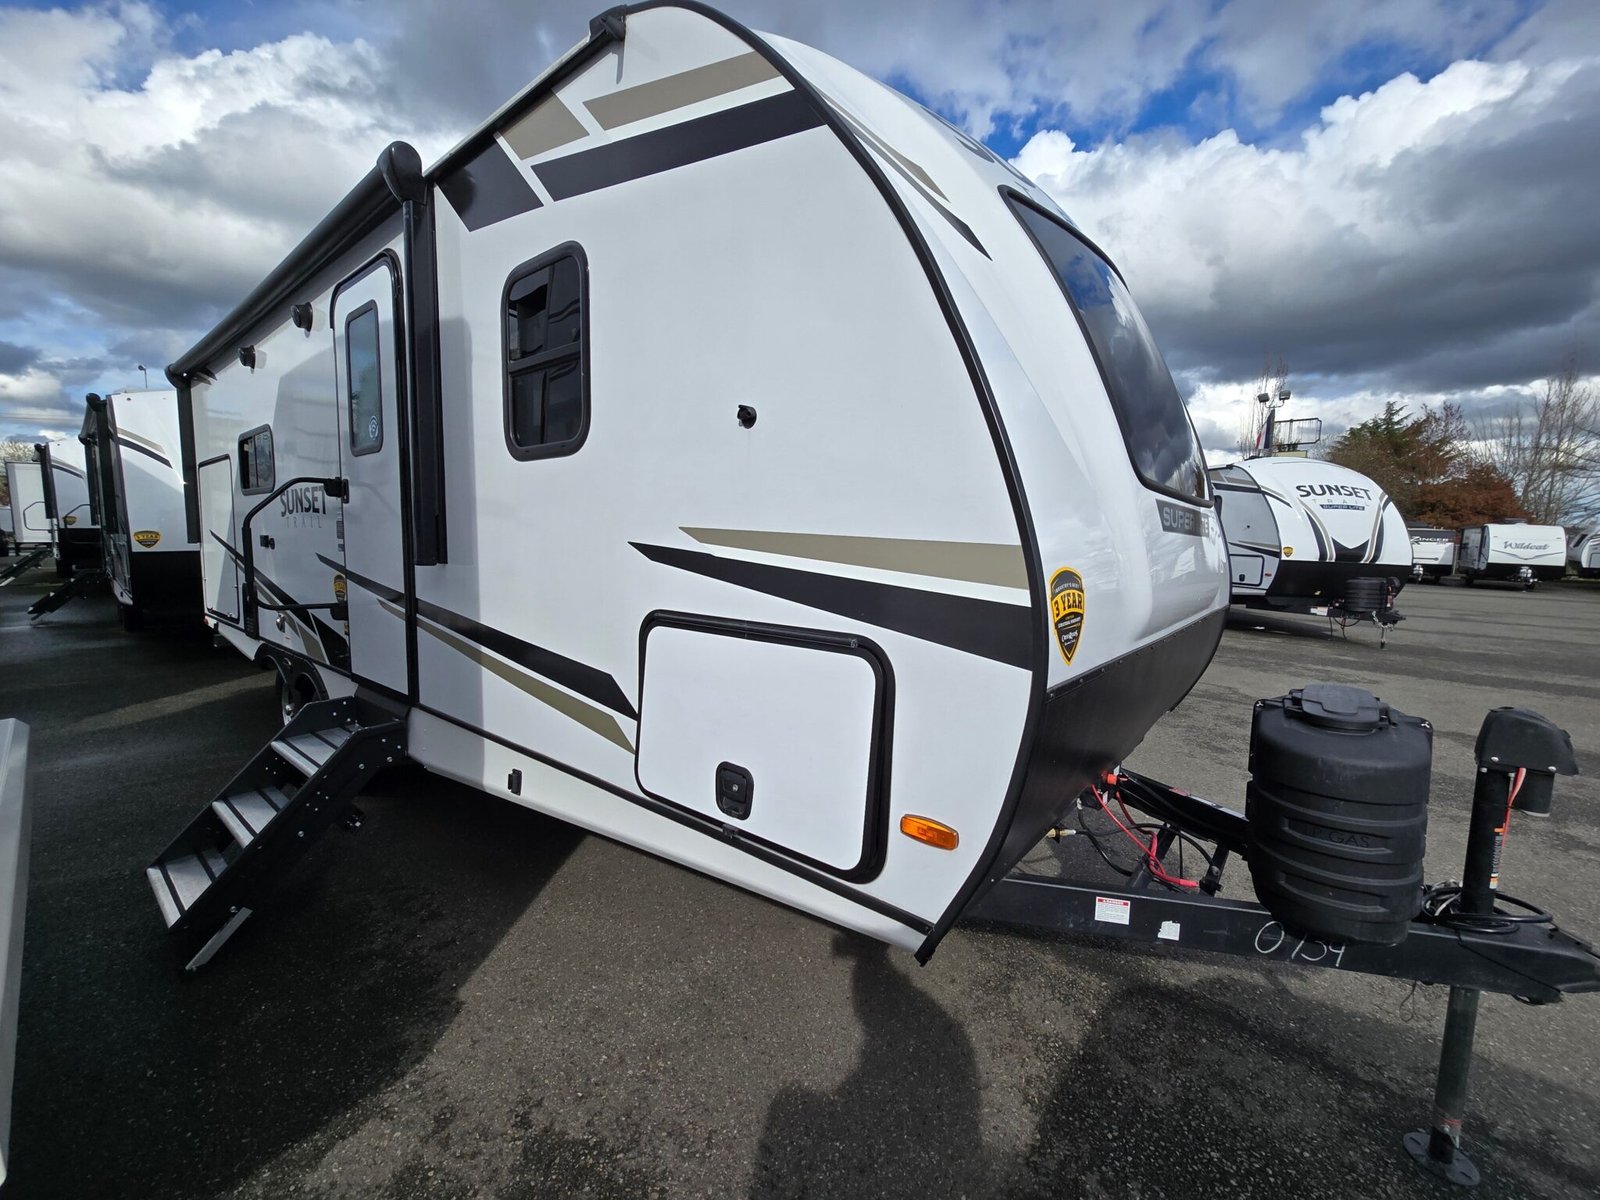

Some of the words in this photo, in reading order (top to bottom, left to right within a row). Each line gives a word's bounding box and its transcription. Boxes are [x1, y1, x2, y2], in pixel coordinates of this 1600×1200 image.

[1296, 484, 1372, 501] SUNSET
[280, 486, 326, 517] SUNSET
[286, 515, 322, 528] TRAIL
[1503, 540, 1549, 551] Wildcat
[1054, 600, 1060, 618] 3
[1060, 592, 1083, 612] YEAR
[1328, 830, 1369, 848] GAS
